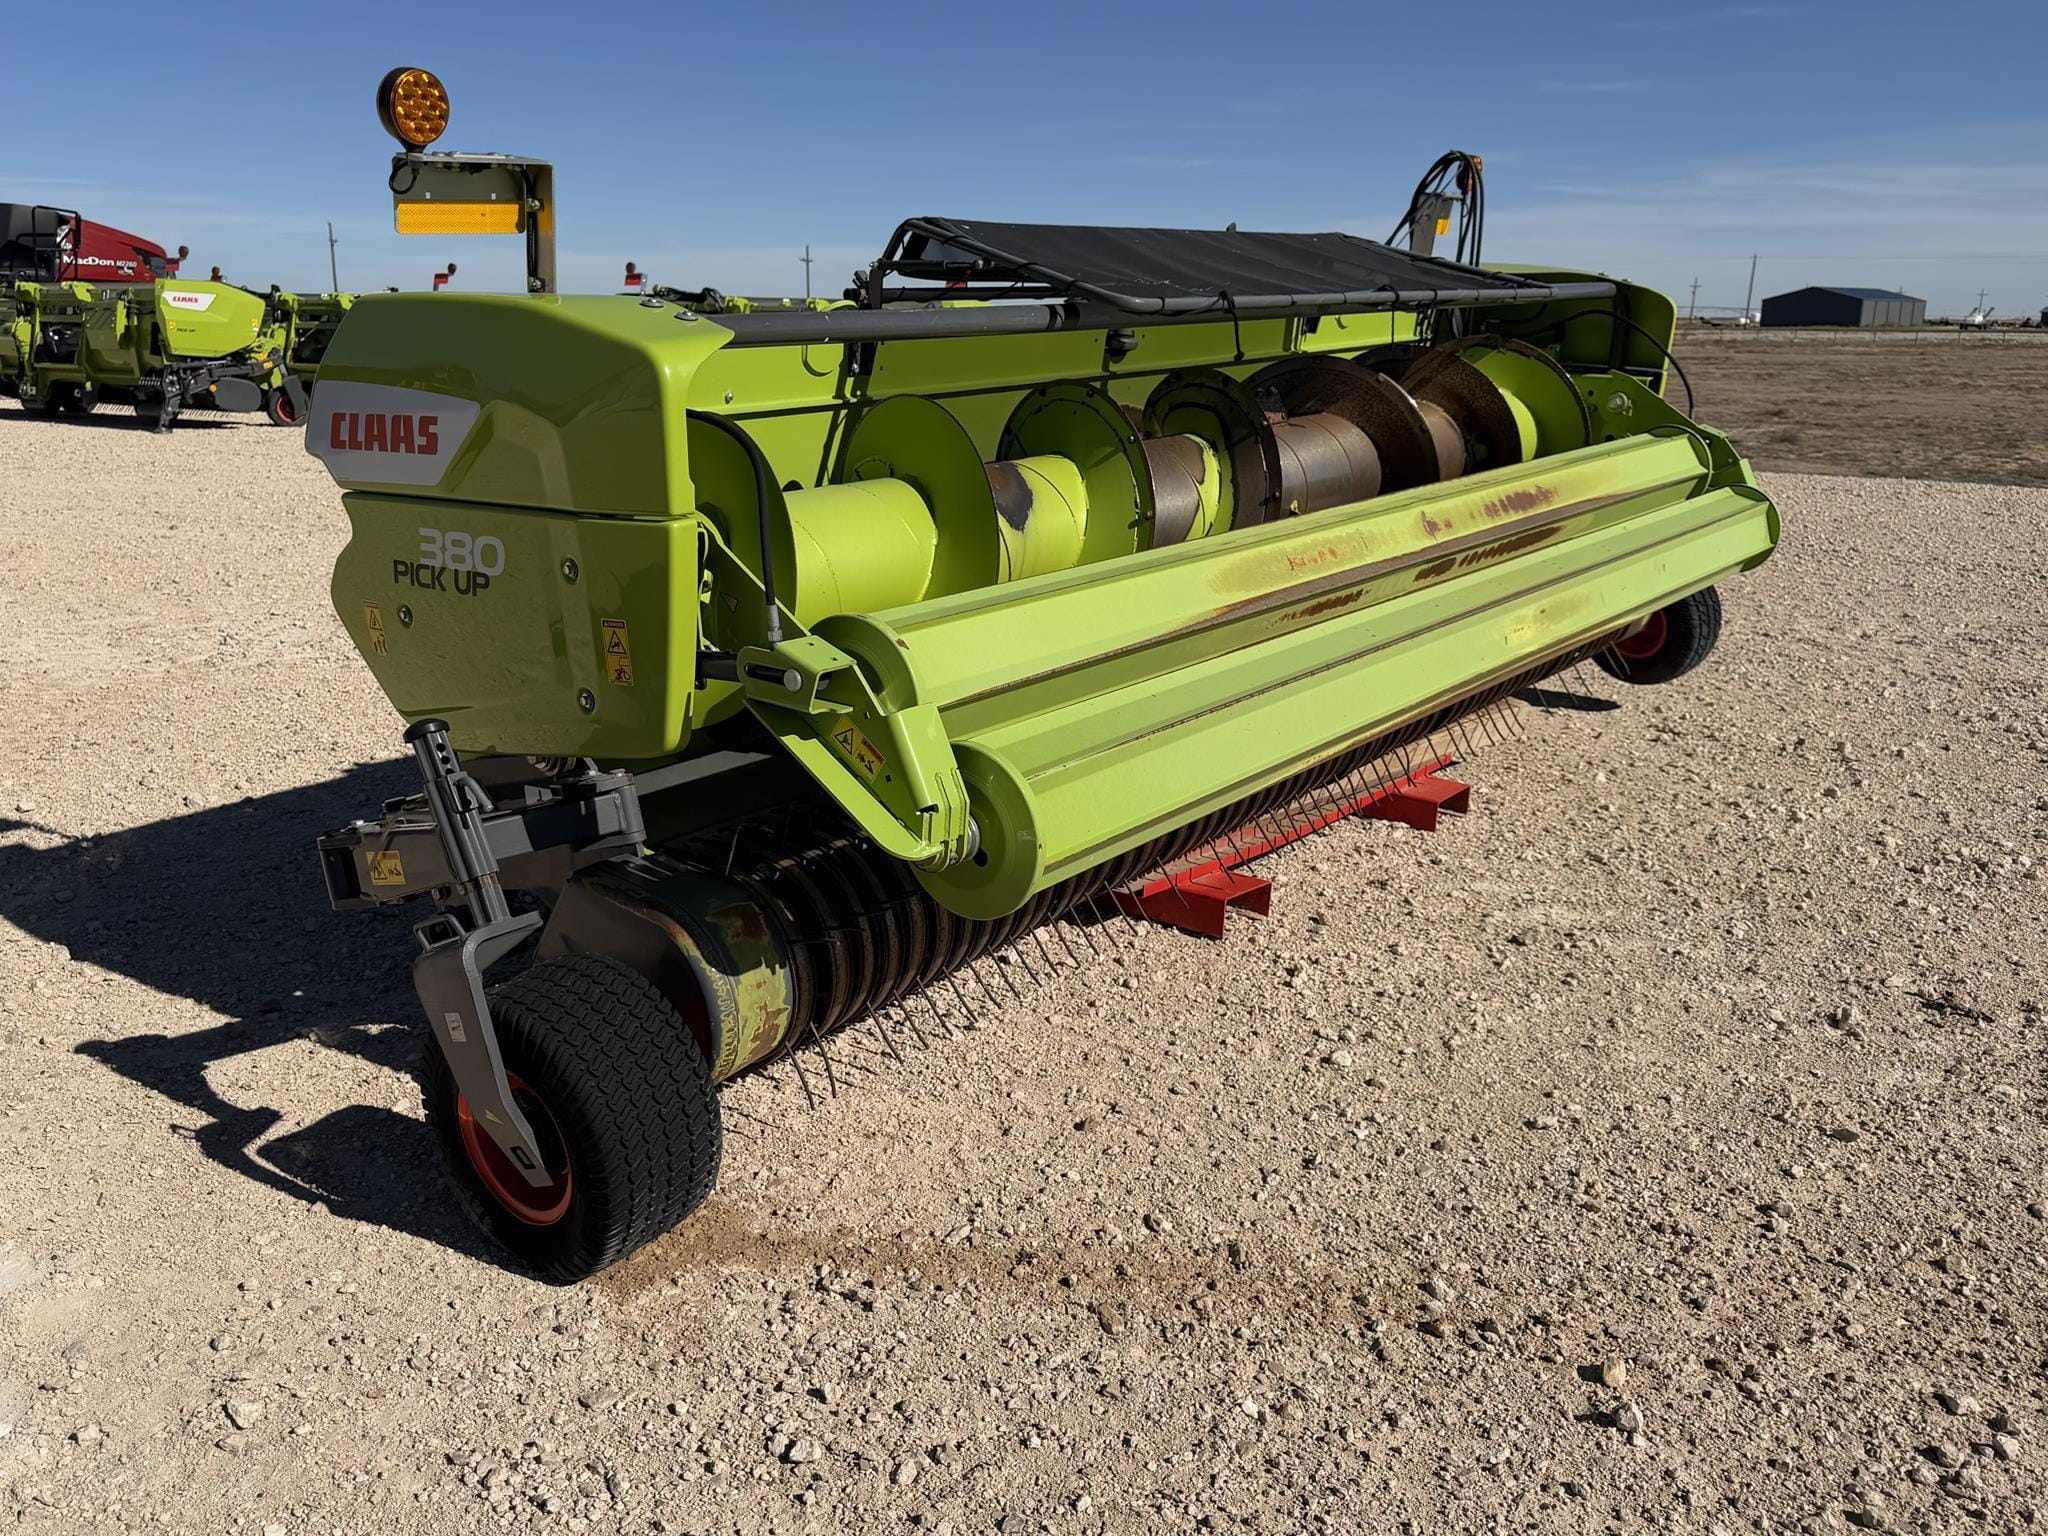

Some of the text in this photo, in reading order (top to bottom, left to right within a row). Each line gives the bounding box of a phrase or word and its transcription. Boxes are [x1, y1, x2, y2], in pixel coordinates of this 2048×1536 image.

[63, 255, 114, 266] MacDon
[330, 412, 439, 456] CLAAS
[418, 528, 505, 576] 380
[393, 559, 490, 596] PICK UP
